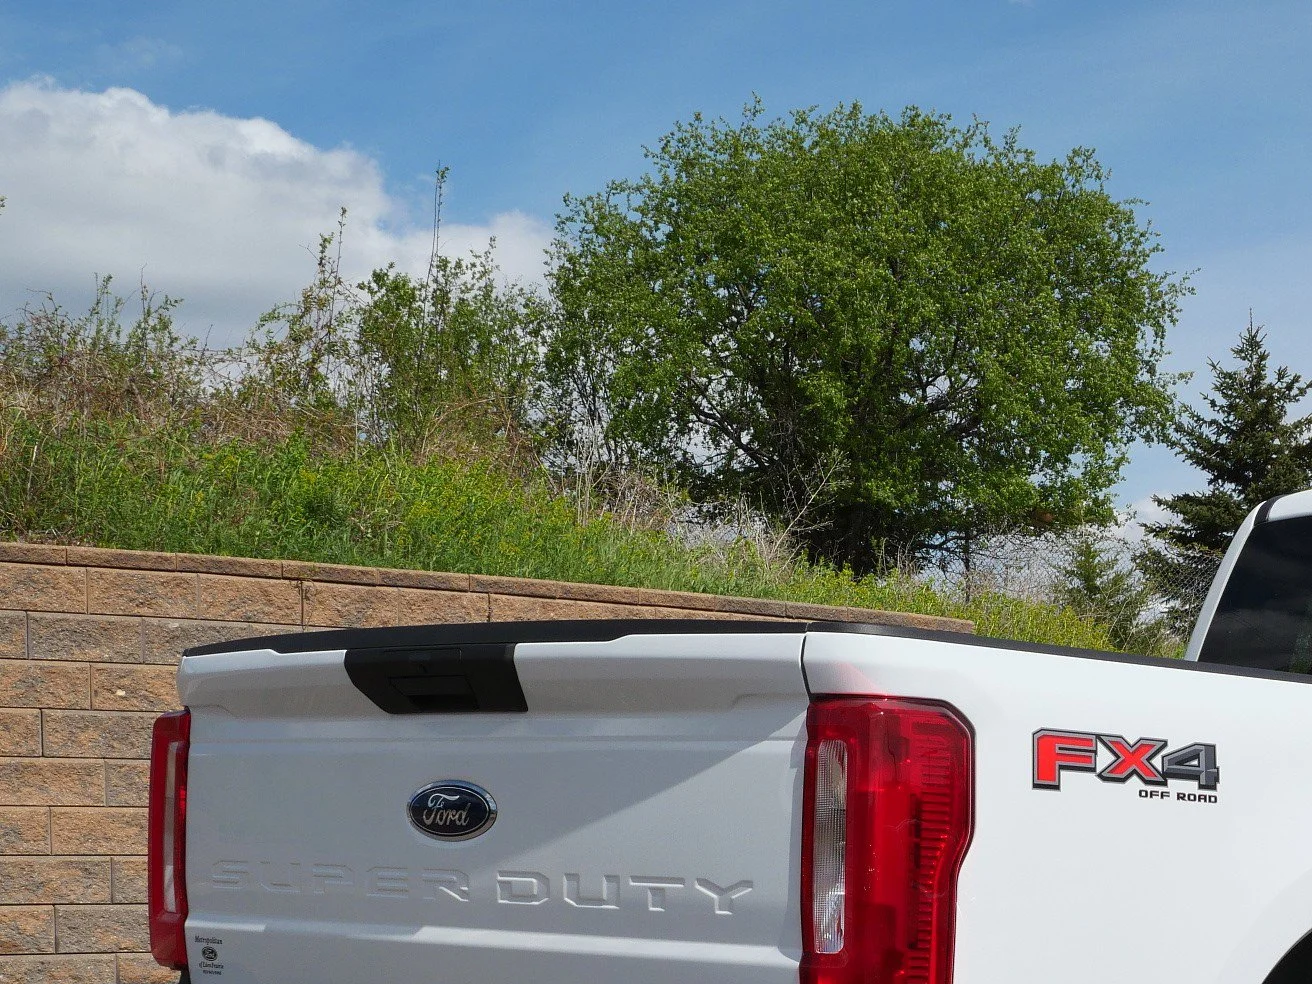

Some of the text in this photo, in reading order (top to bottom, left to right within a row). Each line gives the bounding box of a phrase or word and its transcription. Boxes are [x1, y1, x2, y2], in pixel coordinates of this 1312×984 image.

[1031, 726, 1220, 792] FX4
[423, 793, 471, 826] Ford
[1138, 789, 1218, 804] OFF ROAD
[211, 859, 754, 916] SUPER DUTY
